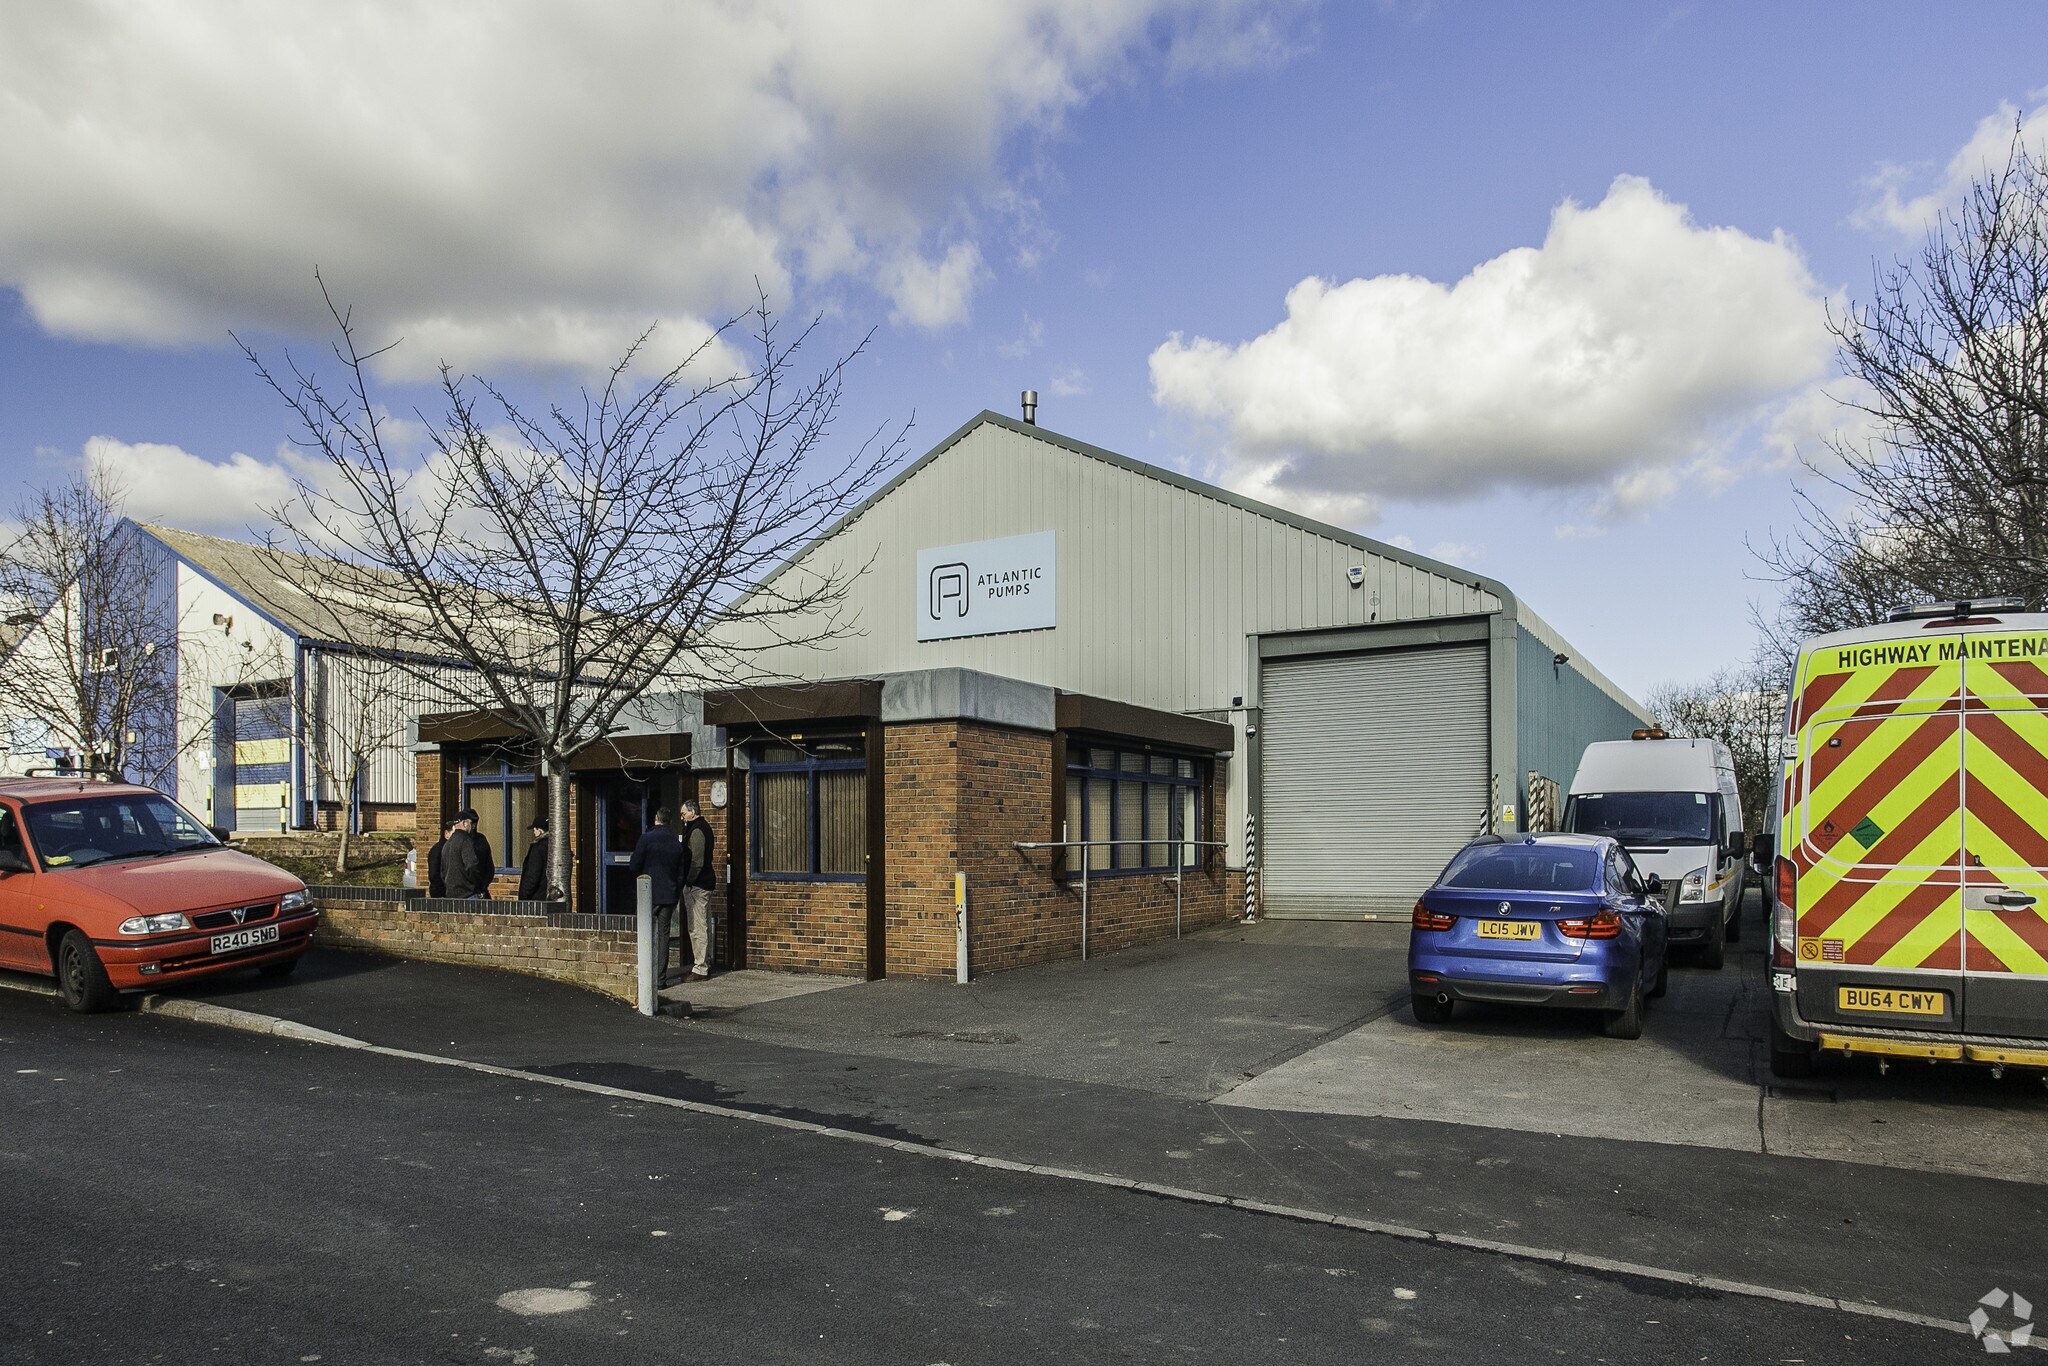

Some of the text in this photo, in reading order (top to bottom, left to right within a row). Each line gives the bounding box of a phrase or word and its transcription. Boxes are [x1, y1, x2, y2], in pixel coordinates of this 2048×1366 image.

[977, 567, 1041, 586] ATLANTIC
[988, 583, 1030, 599] PUMPS
[1838, 644, 1931, 668] HIGHWAY
[1482, 922, 1536, 936] LC15 JWV
[213, 927, 277, 951] R240 SND
[1847, 990, 1935, 1010] BU64 CWY
